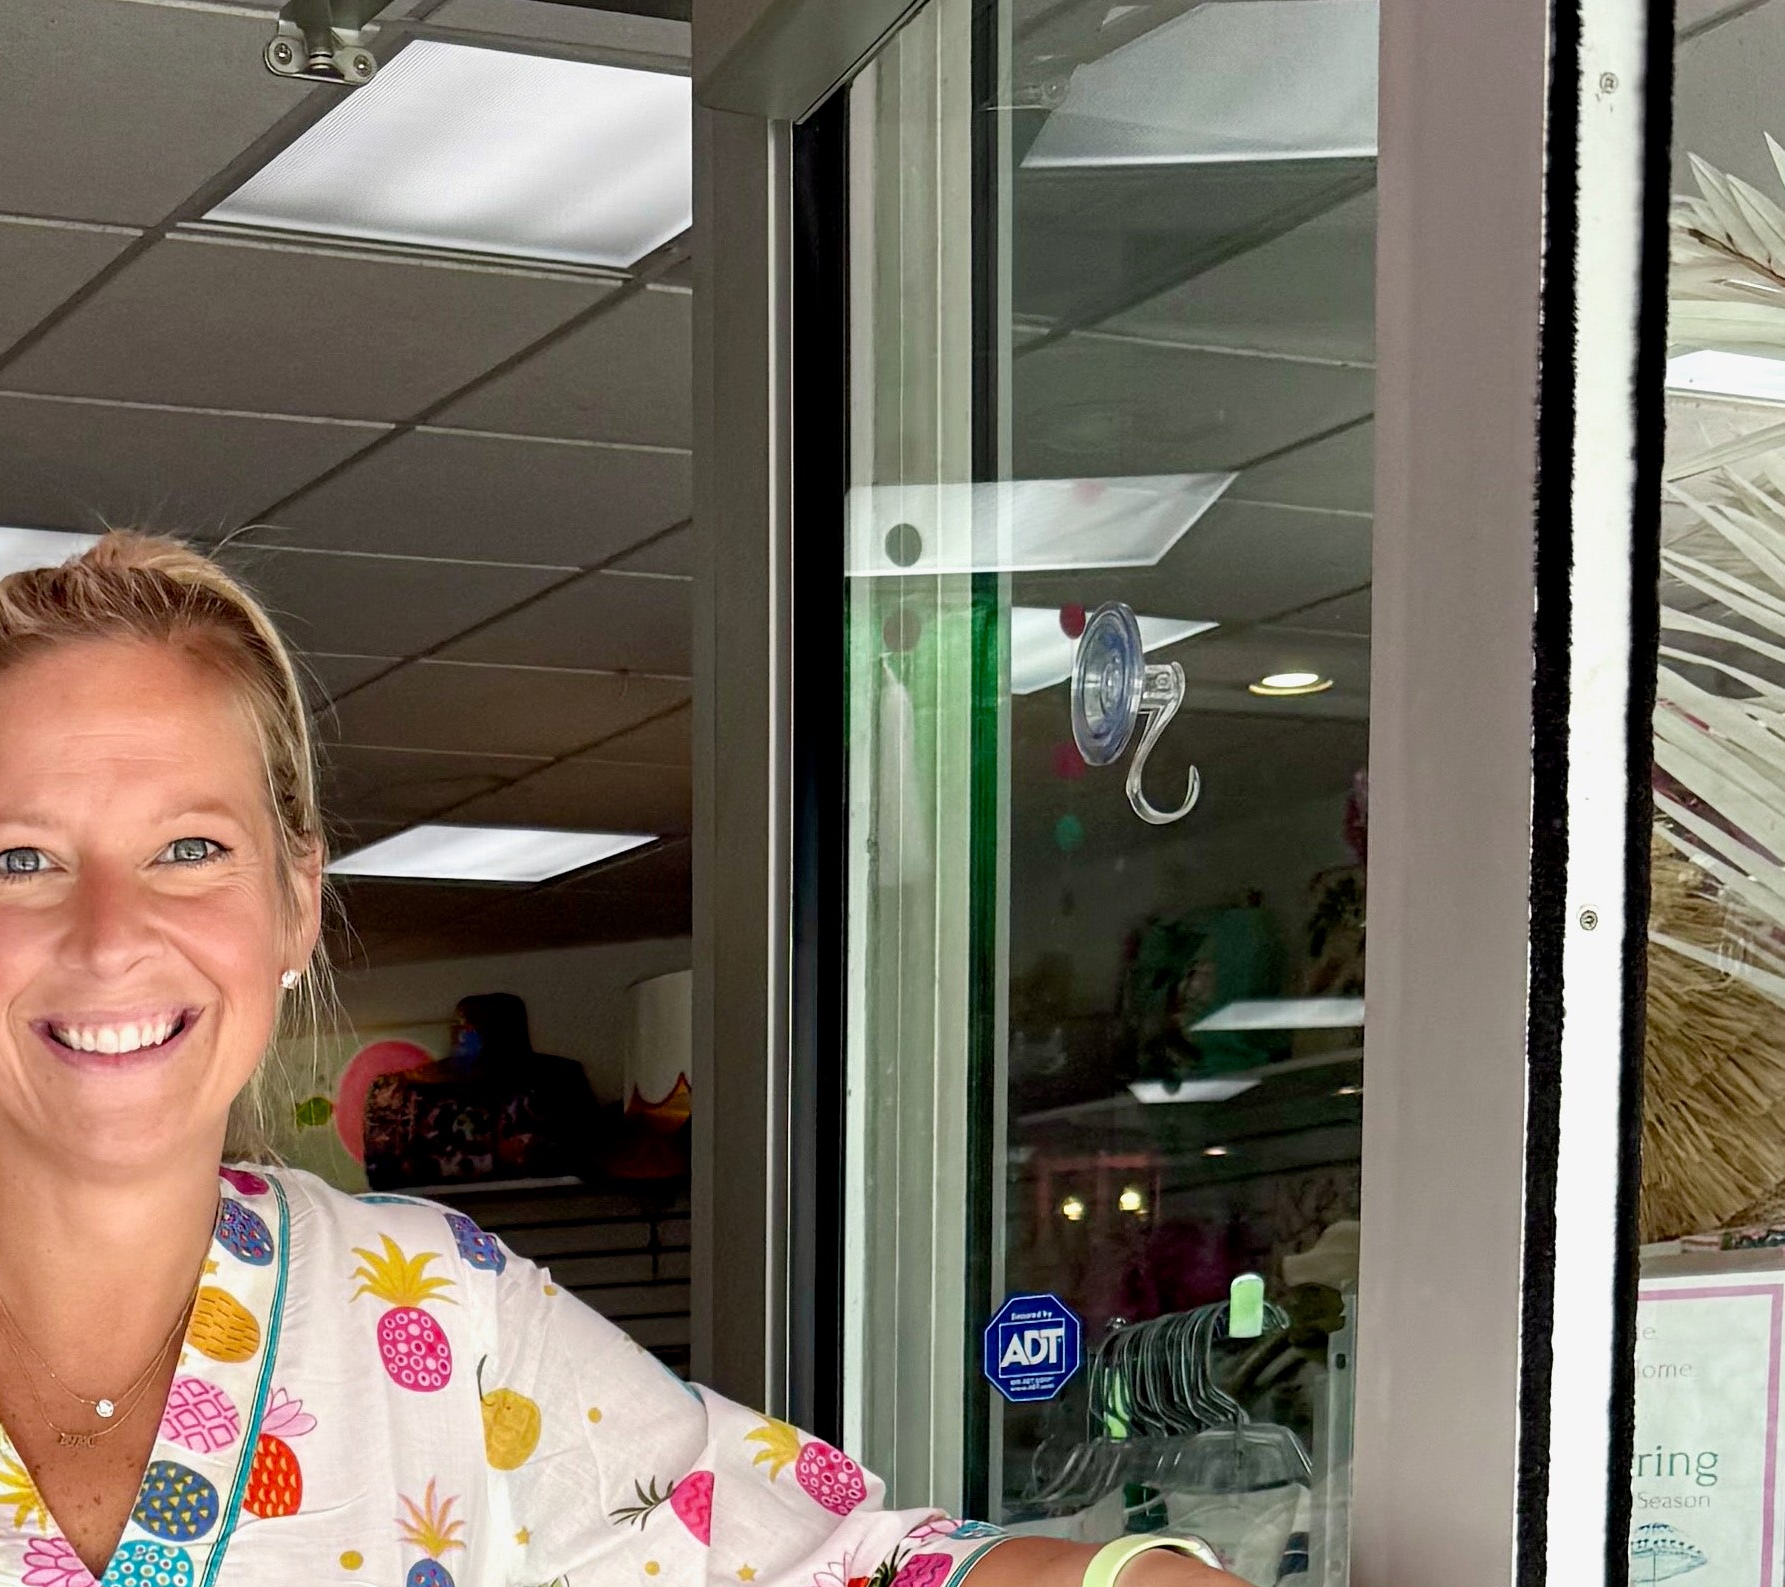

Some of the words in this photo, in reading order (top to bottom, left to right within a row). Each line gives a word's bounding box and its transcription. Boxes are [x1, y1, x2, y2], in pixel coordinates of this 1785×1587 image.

[1000, 1328, 1064, 1368] ADT
[1637, 1445, 1718, 1487] ring
[1637, 1491, 1711, 1510] Season
